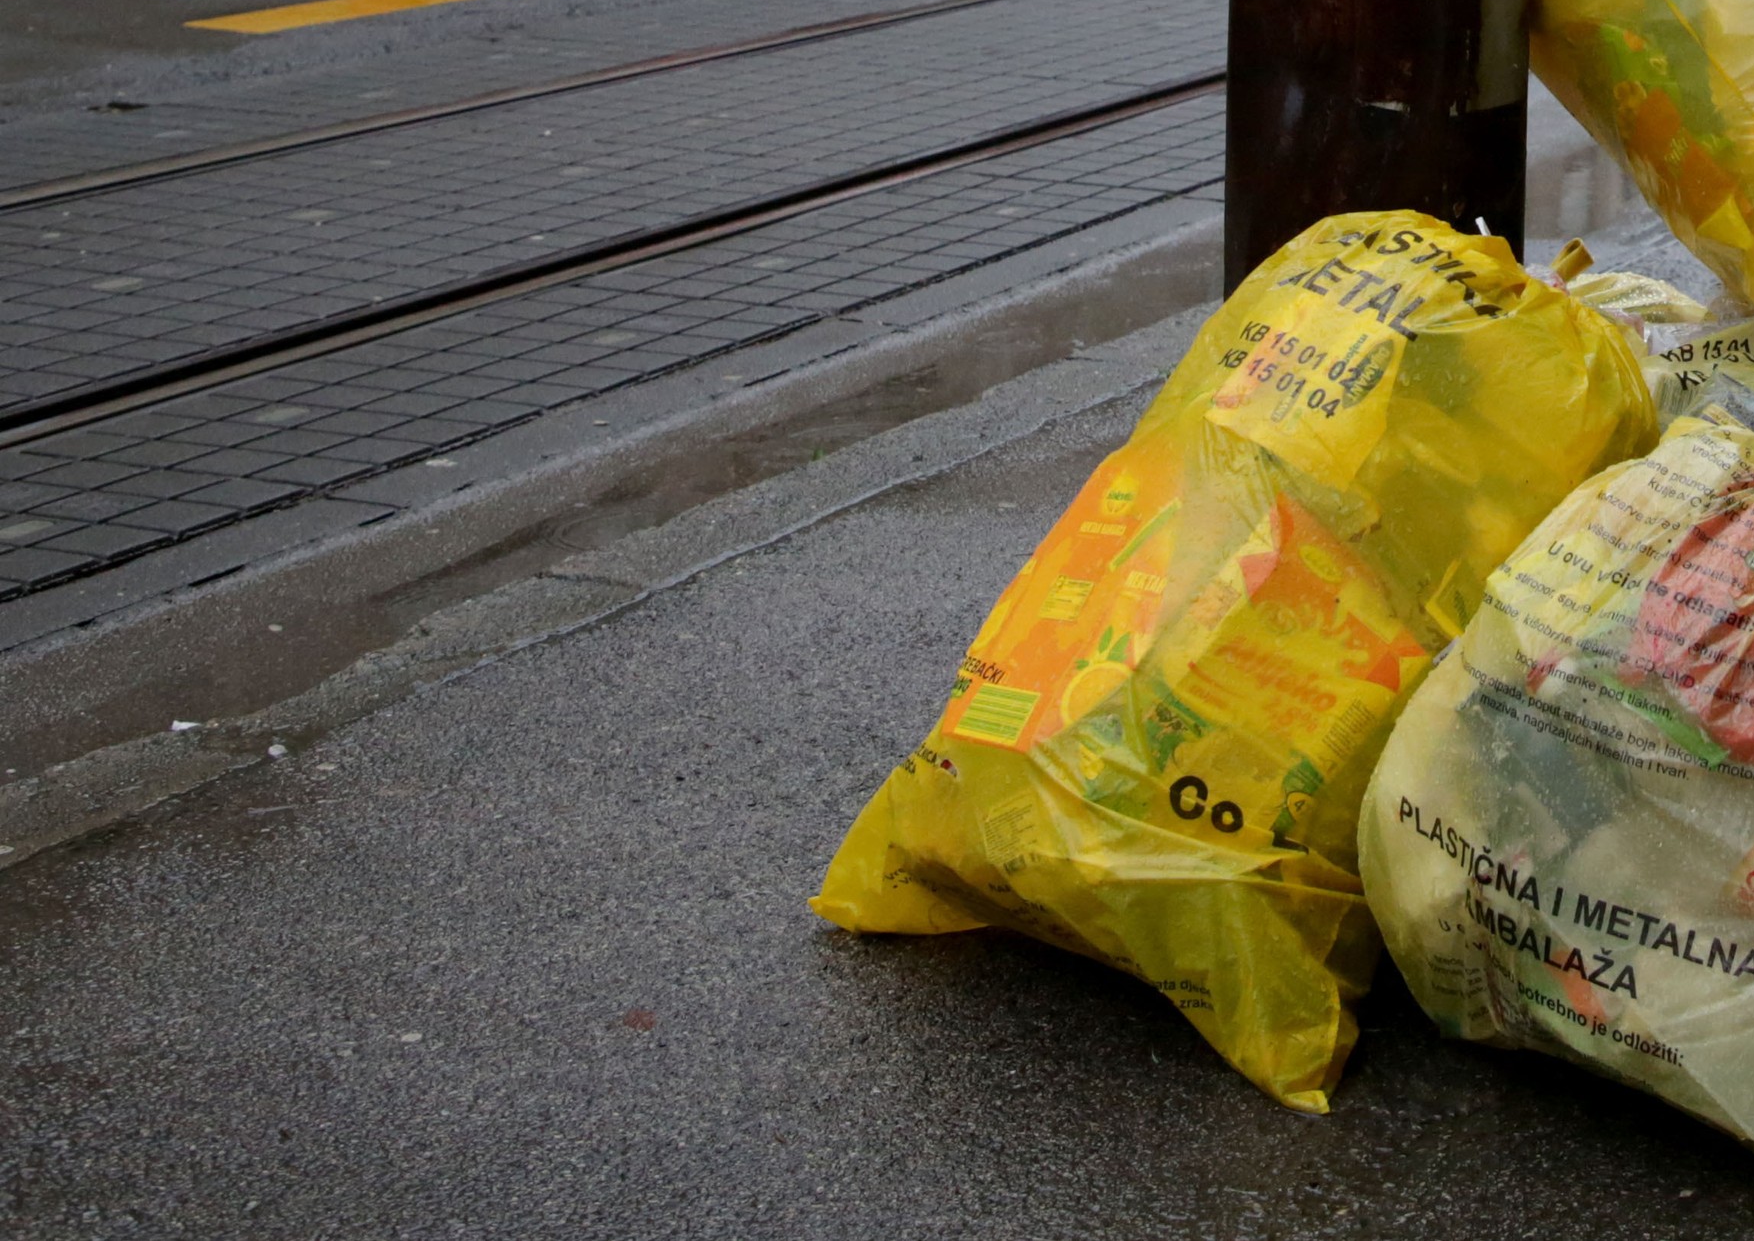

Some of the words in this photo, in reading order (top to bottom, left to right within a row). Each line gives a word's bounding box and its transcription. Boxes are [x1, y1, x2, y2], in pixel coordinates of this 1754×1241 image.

[1217, 347, 1248, 369] KB
[1247, 358, 1277, 384] 15
[1275, 371, 1307, 399] 01
[1307, 388, 1343, 419] 04
[1240, 320, 1271, 342] KB
[1271, 332, 1300, 356] 15
[1297, 345, 1328, 371] 01
[1327, 360, 1362, 391] 02
[1702, 339, 1724, 361] 15
[1514, 571, 1555, 599] stiropor,
[1547, 540, 1565, 556] U
[1562, 551, 1594, 574] ovu
[1647, 579, 1669, 597] ne
[1481, 591, 1494, 605] za
[1493, 599, 1520, 619] zube,
[1549, 663, 1597, 692] limenke
[1599, 684, 1625, 702] pod
[1626, 687, 1674, 722] tlakom,
[1478, 692, 1521, 722] maziva,
[1522, 712, 1594, 751] nagrizajućih
[1594, 739, 1644, 771] kiselina
[1655, 761, 1691, 781] tvari.
[1527, 695, 1563, 718] poput
[1562, 708, 1625, 742] ambalaže
[1663, 743, 1714, 772] lakova,
[1399, 795, 1541, 910] PLASTIČNA
[1551, 886, 1564, 917] I
[1465, 888, 1639, 1000] AMBALAŽA
[1516, 978, 1588, 1027] potrebno
[1590, 1016, 1608, 1037] je
[1611, 1028, 1685, 1068] odložiti:
